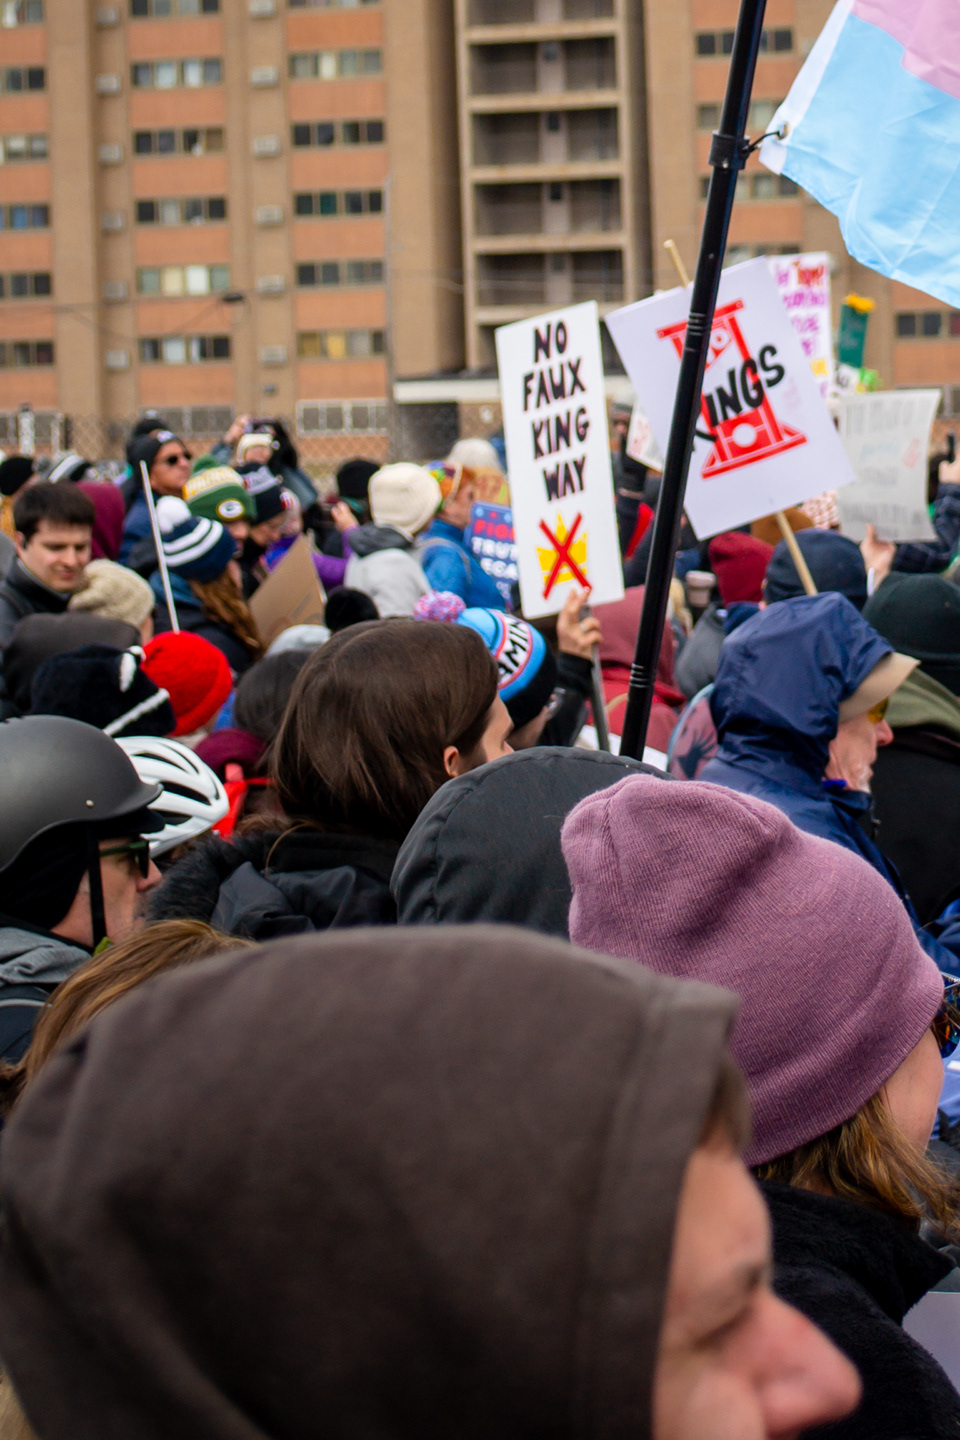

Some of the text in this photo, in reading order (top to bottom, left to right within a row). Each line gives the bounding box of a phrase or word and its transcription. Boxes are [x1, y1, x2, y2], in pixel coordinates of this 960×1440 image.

[534, 321, 568, 364] NO
[523, 357, 587, 412] FAUX
[532, 407, 590, 461] KING
[543, 455, 587, 503] WAY
[471, 536, 519, 562] TRUT
